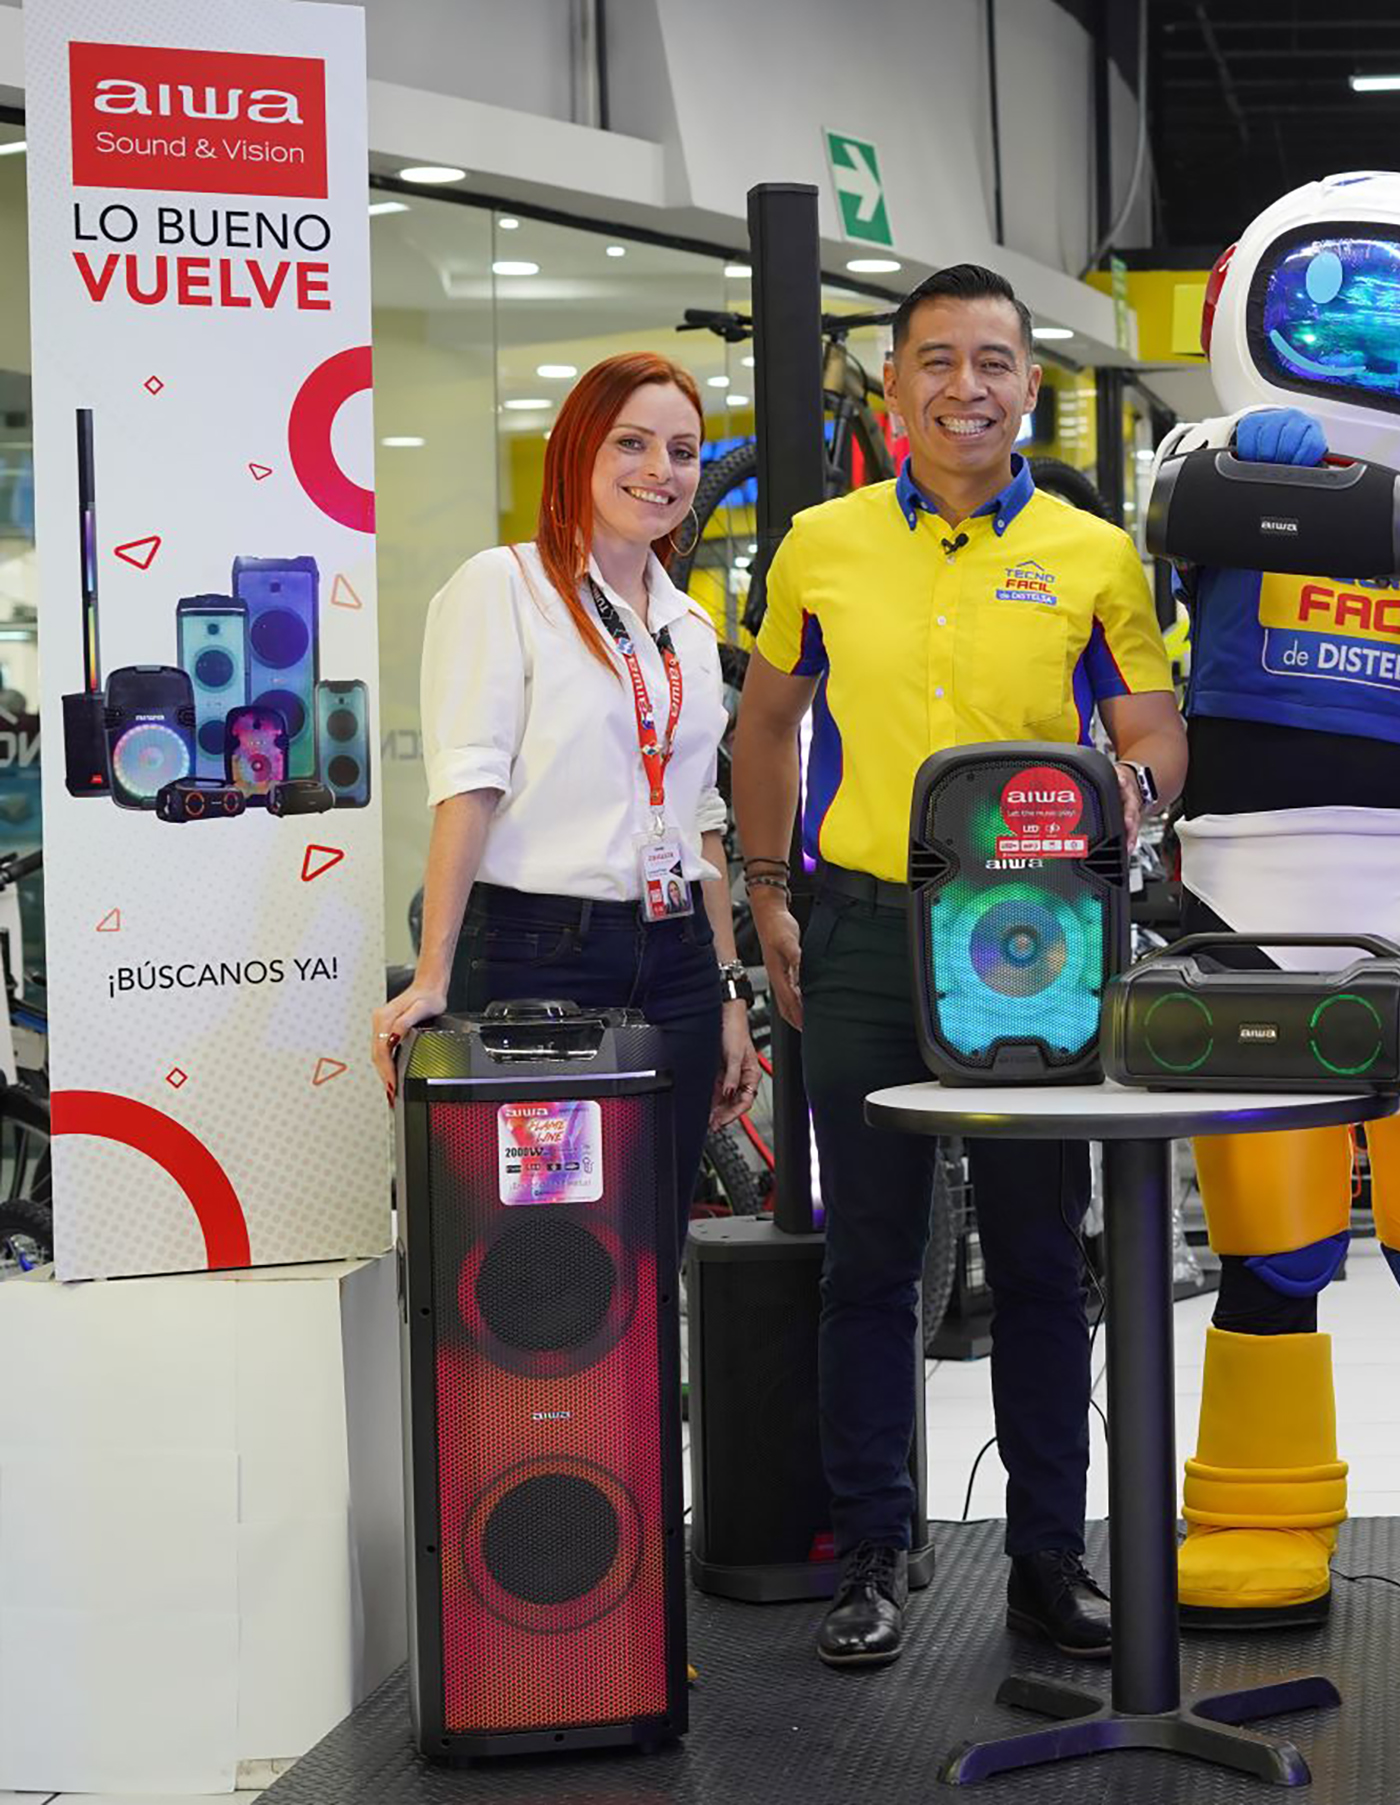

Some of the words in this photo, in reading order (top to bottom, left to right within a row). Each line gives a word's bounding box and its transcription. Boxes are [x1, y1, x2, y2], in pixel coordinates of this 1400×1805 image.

[93, 78, 304, 125] aiwa
[96, 132, 187, 158] Sound
[194, 138, 217, 160] &
[223, 139, 305, 164] Vision
[74, 203, 139, 242] LO
[157, 207, 332, 252] BUENO
[72, 252, 332, 312] VUELVE
[1260, 519, 1299, 532] aiwa
[1005, 568, 1056, 584] TECNO
[1005, 578, 1053, 594] FACIL
[1011, 591, 1053, 604] DISTELSA
[1283, 640, 1309, 667] de
[669, 667, 682, 718] aiwa
[1006, 790, 1076, 803] aiwa
[985, 858, 1044, 870] aiwa
[108, 958, 285, 998] ¡BÚSCANOS
[293, 957, 339, 982] YA!
[1240, 1028, 1277, 1039] aiwa
[505, 1107, 549, 1118] aiwa
[505, 1147, 545, 1159] 2000W
[532, 1411, 571, 1420] aiwa
